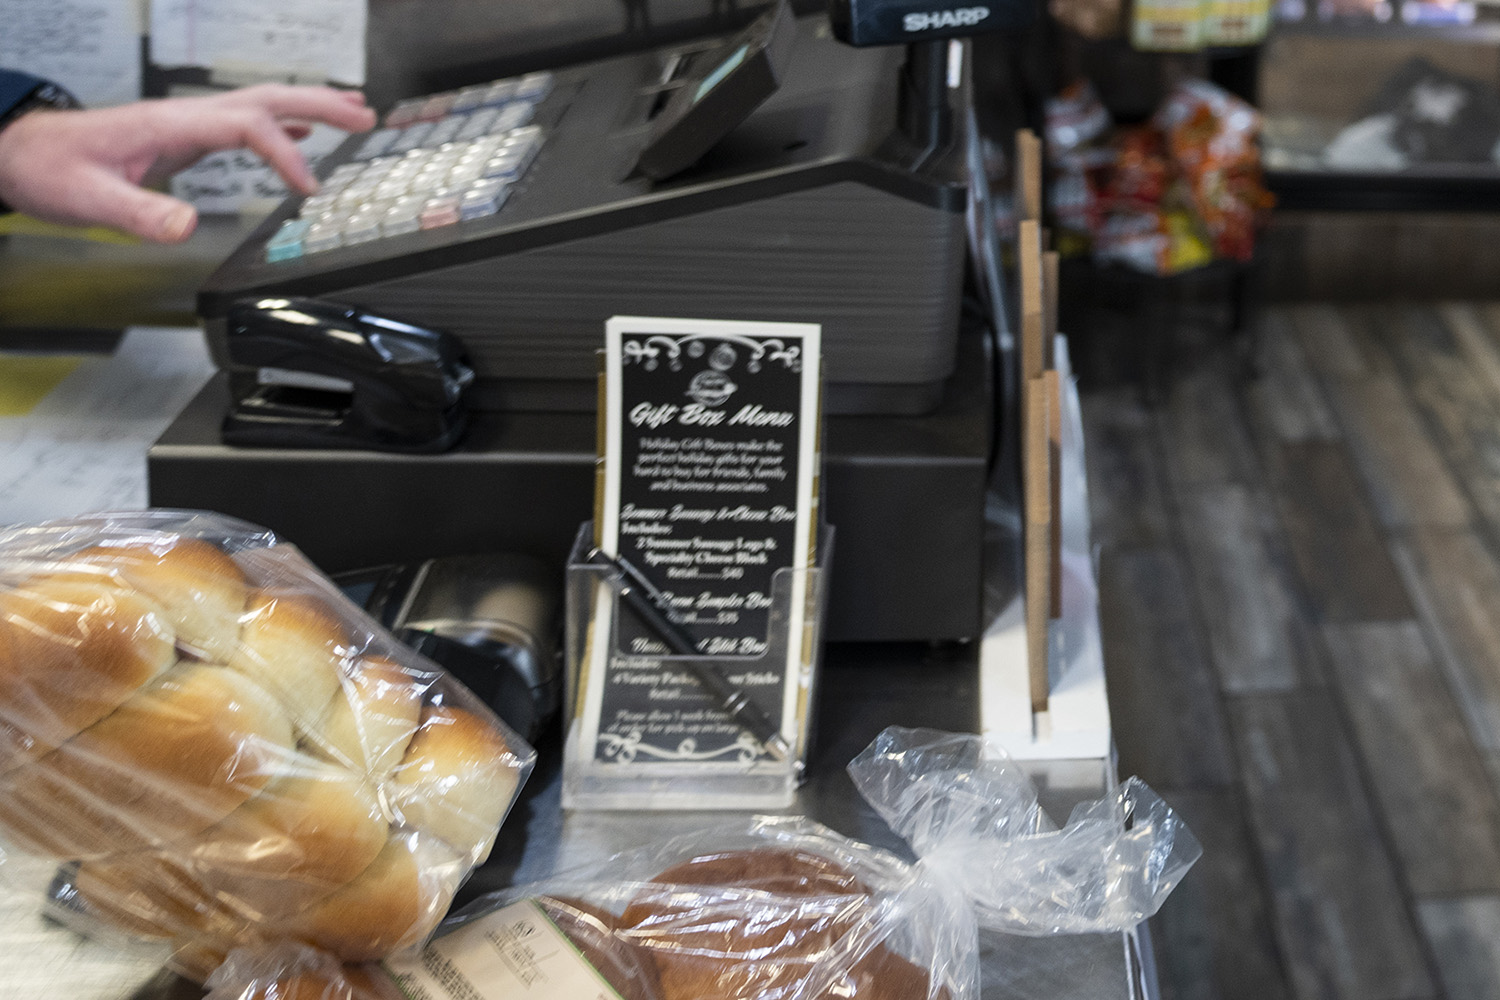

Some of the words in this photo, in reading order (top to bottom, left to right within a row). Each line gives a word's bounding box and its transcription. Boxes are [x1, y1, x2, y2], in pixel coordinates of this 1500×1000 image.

[903, 6, 991, 33] SHARP
[629, 402, 680, 429] Gift
[678, 403, 727, 427] Box
[727, 404, 795, 427] Menu
